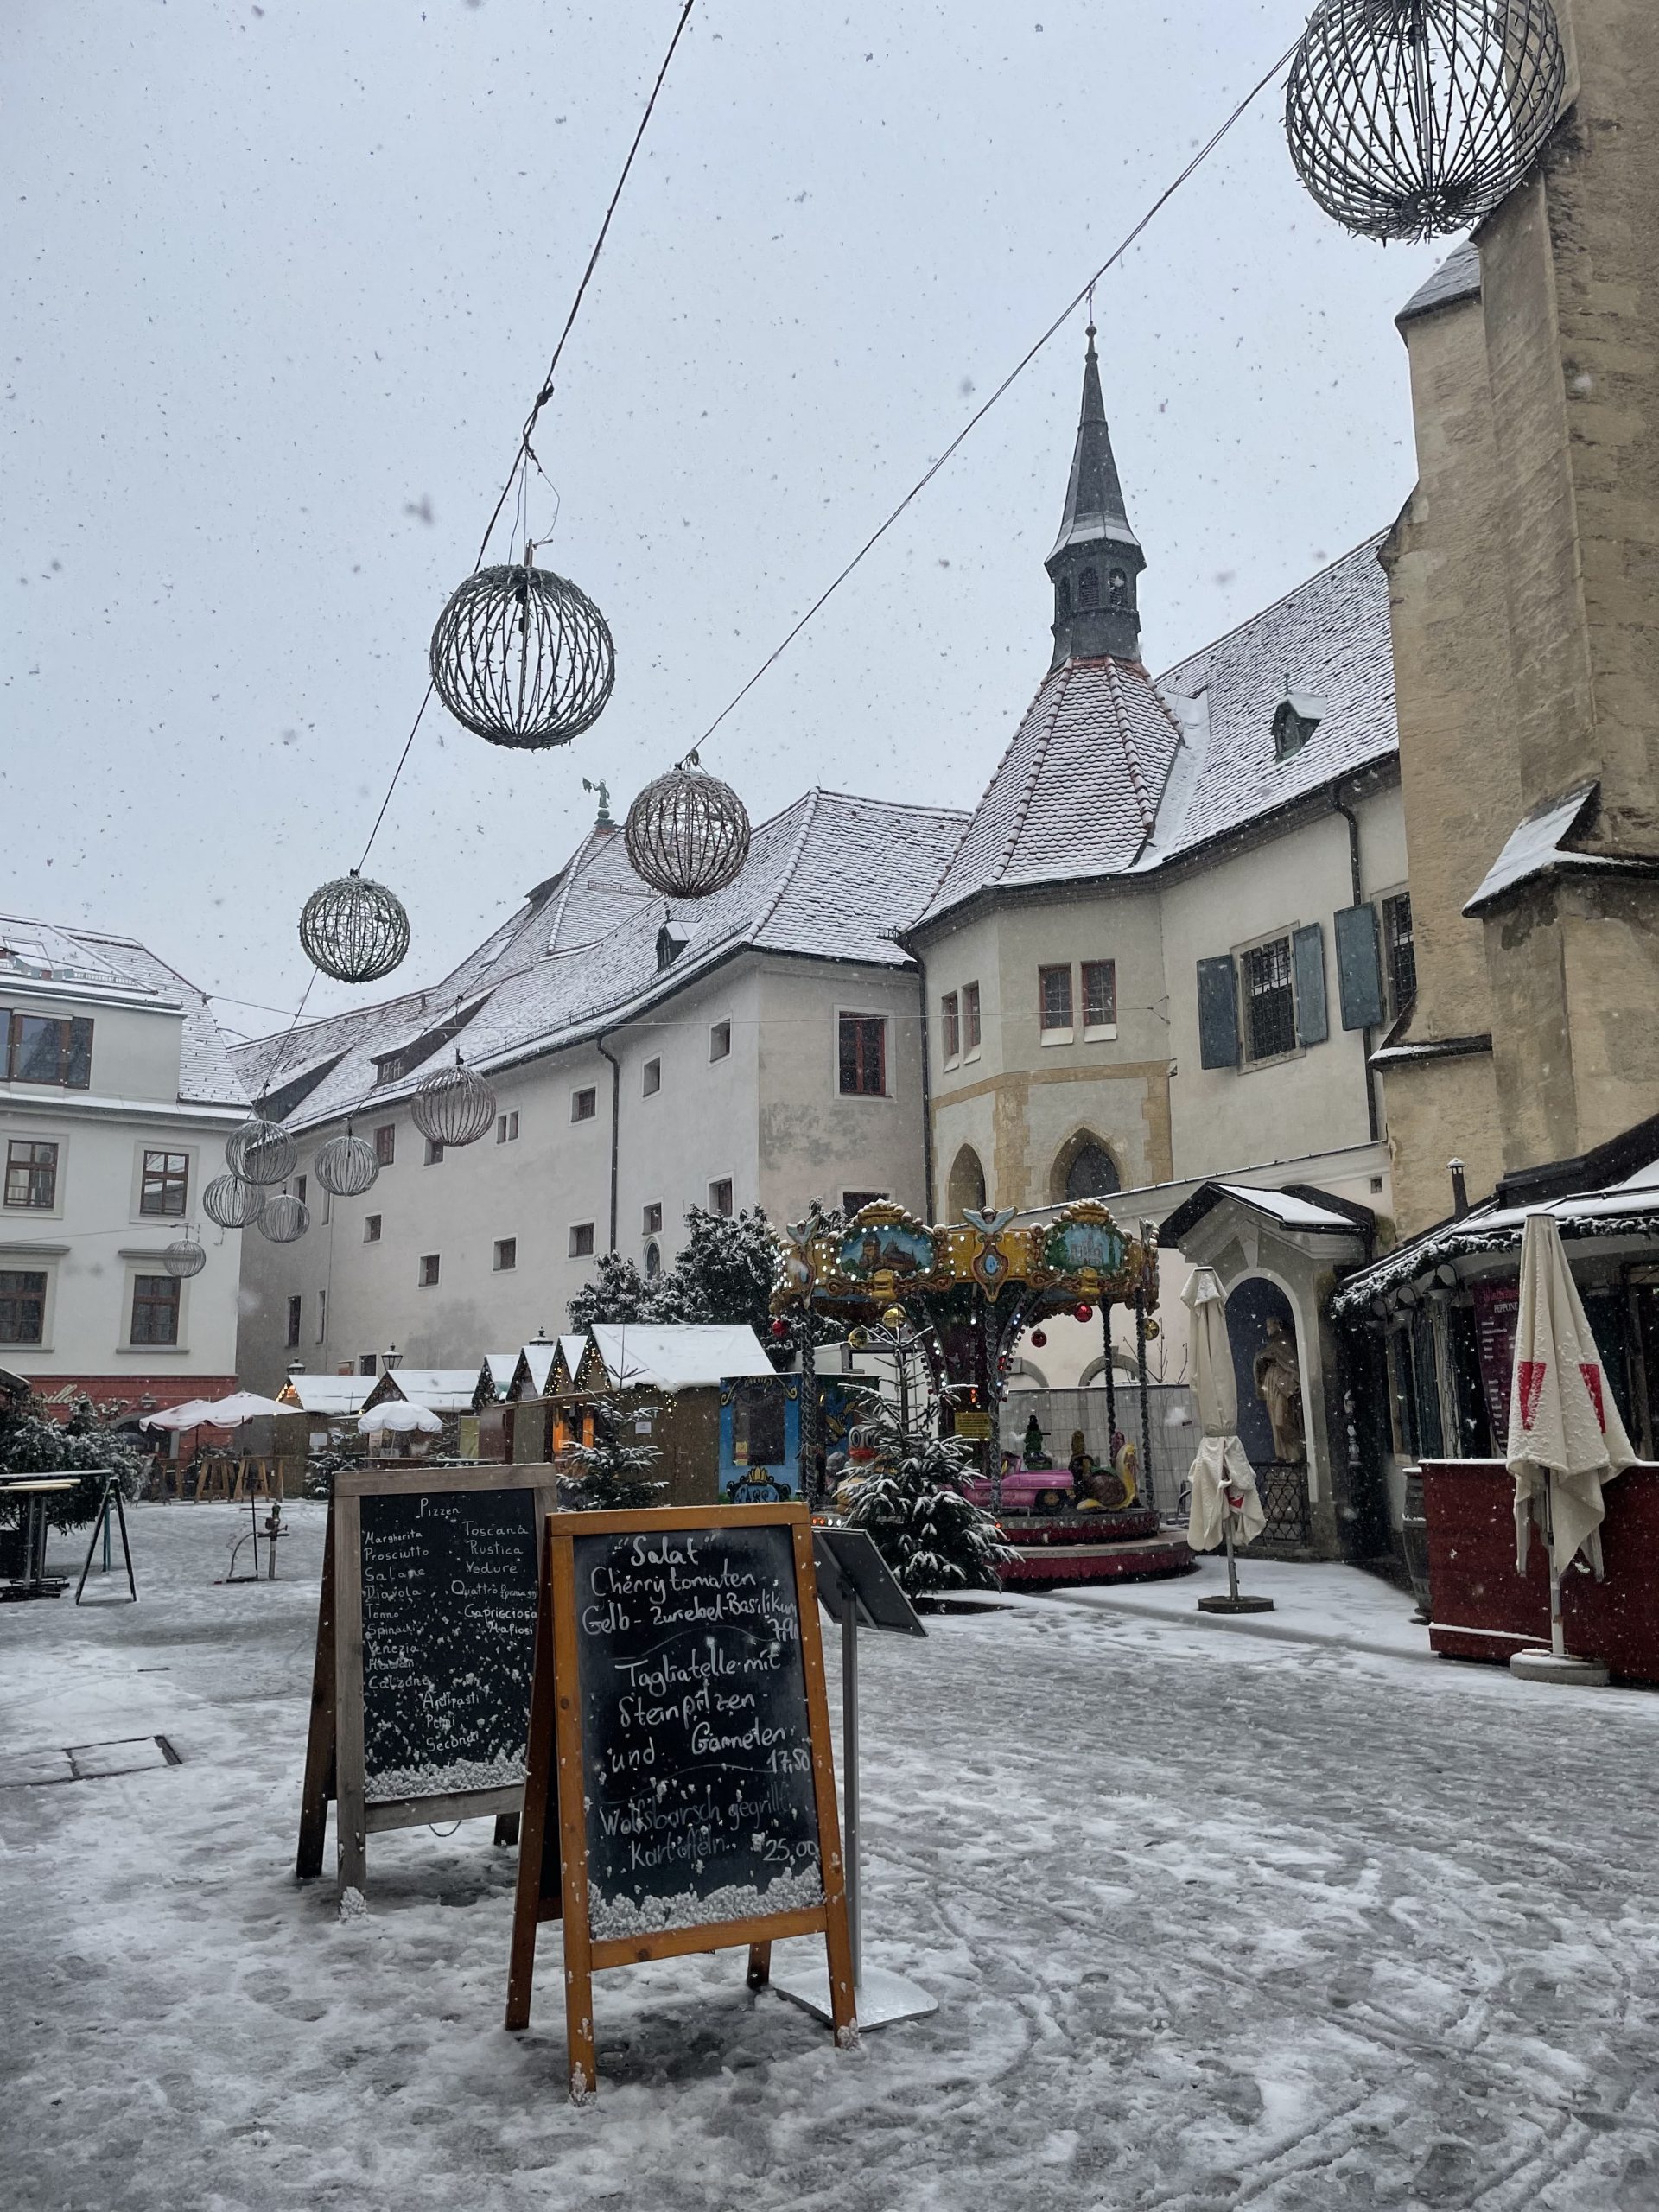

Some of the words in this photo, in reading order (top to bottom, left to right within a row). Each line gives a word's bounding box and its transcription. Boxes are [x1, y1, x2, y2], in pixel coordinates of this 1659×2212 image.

[420, 1497, 460, 1517] Pizzen
[365, 1529, 423, 1545] Margherita
[462, 1521, 529, 1536] Toscana
[364, 1545, 429, 1562] Prosciutto
[466, 1540, 524, 1554] Rustica
[466, 1561, 518, 1573] Vedure
[365, 1585, 422, 1602] Diavola
[451, 1580, 498, 1595] Quattro
[365, 1603, 399, 1618] Tonno
[464, 1604, 538, 1624] Capricciosa
[488, 1622, 533, 1636] Mafiosi
[368, 1641, 420, 1656] Venezia
[614, 1645, 736, 1698] Tagliatelle
[744, 1643, 781, 1674] mit
[368, 1675, 431, 1691] Calzone
[423, 1690, 479, 1710] Antipasti
[426, 1731, 479, 1752] Secondi
[612, 1736, 656, 1773] und
[766, 1748, 811, 1774] 17,50
[599, 1794, 721, 1836] Wolfsbarsch
[762, 1837, 819, 1862] 25,00
